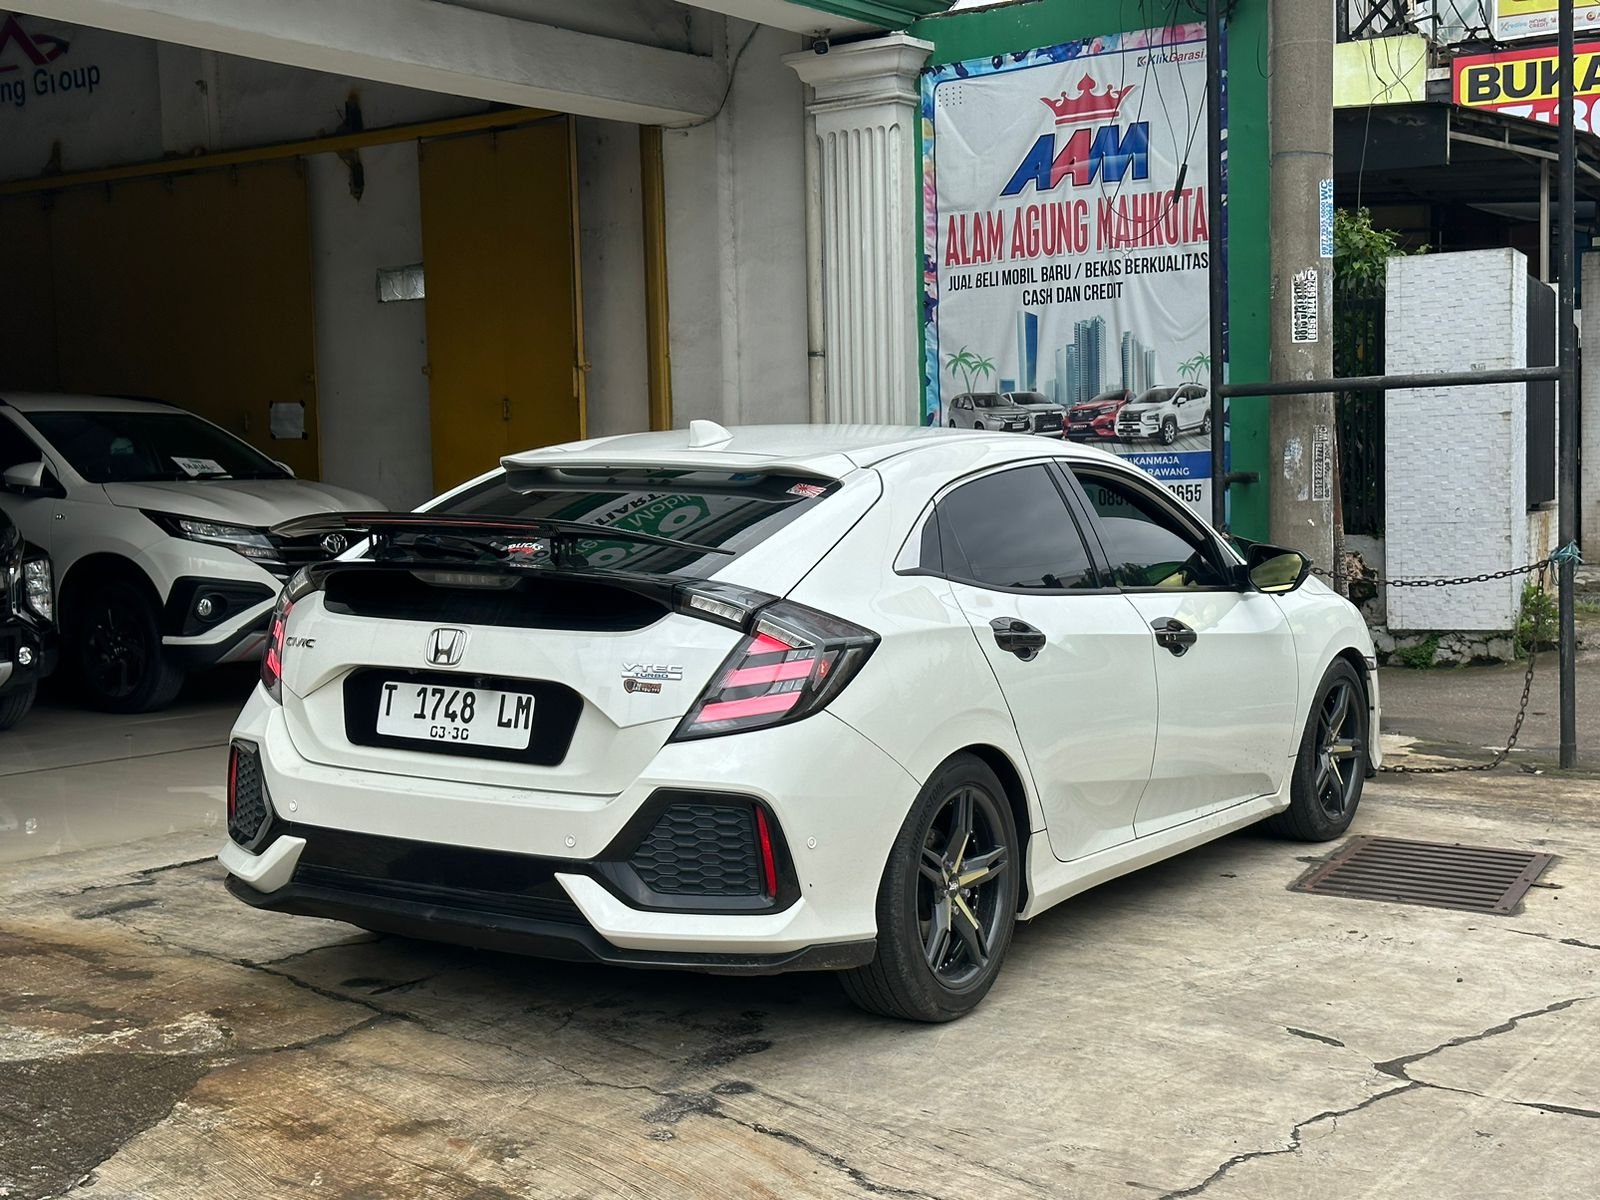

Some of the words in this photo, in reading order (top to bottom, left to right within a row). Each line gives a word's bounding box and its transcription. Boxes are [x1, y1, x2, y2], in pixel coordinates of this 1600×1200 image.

[1000, 121, 1150, 196] AAM
[945, 209, 1004, 267] ALAM
[1011, 198, 1089, 260] AGUNG
[1097, 186, 1209, 251] MAHKOTA
[948, 274, 973, 292] JUAL
[976, 272, 999, 289] BELI
[1001, 267, 1038, 286] MOBIL
[1041, 263, 1072, 283] BARU
[1085, 258, 1122, 278] BEKAS
[1125, 251, 1209, 275] BERKUALITAS
[1022, 287, 1053, 306] CASH
[1056, 285, 1081, 304] DAN
[1084, 281, 1124, 302] CREDIT
[286, 636, 316, 648] CIVIC
[622, 662, 683, 674] VTEC
[384, 684, 398, 716] T
[413, 686, 476, 724] 1748
[497, 694, 533, 730] LM
